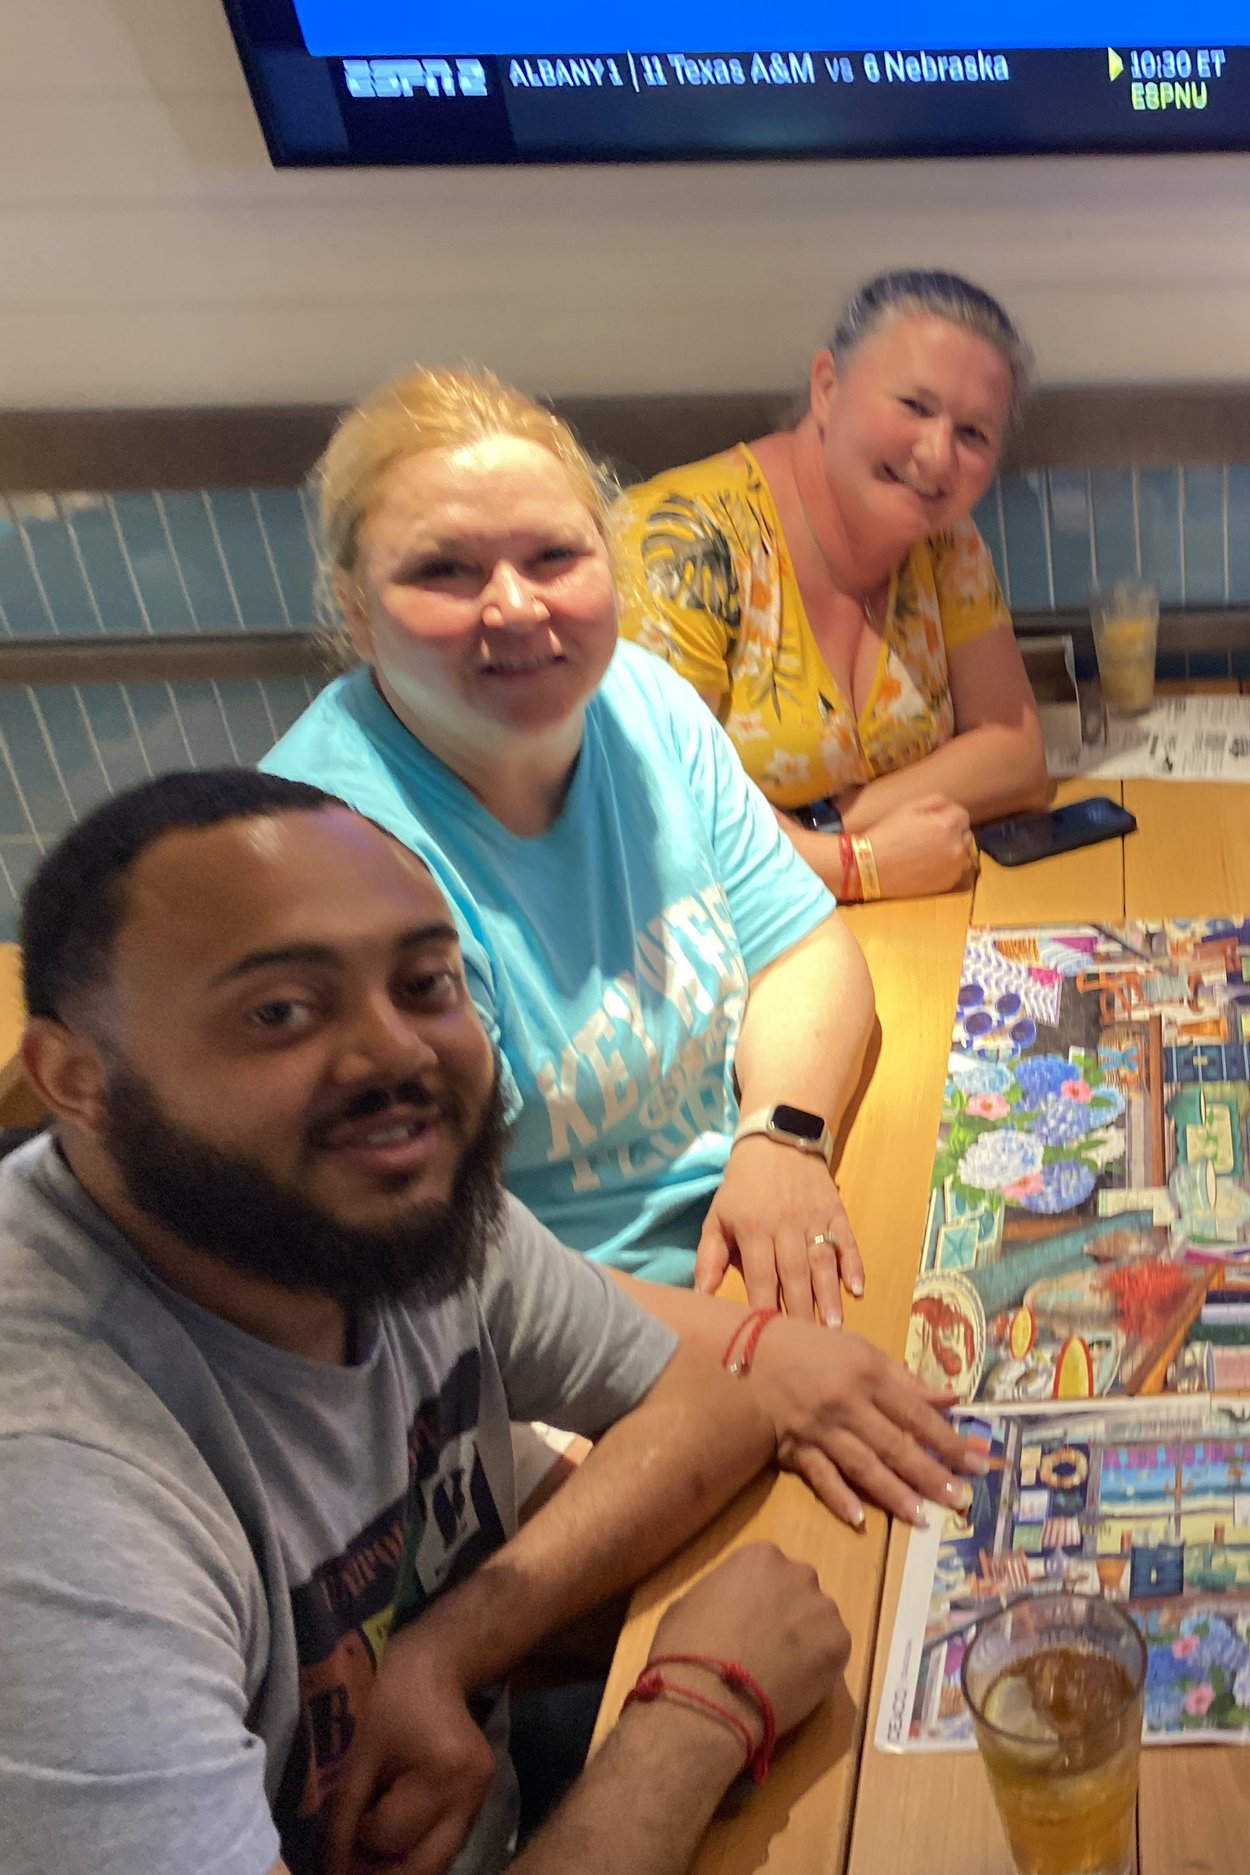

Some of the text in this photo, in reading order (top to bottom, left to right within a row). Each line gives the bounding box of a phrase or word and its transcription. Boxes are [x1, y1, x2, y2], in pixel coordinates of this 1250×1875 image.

[666, 53, 745, 85] Texas
[750, 51, 815, 85] A&M
[824, 56, 864, 83] vs
[883, 50, 1010, 83] Nebraska
[1130, 49, 1226, 79] 10:30 ET
[1131, 81, 1207, 110] ESPNU
